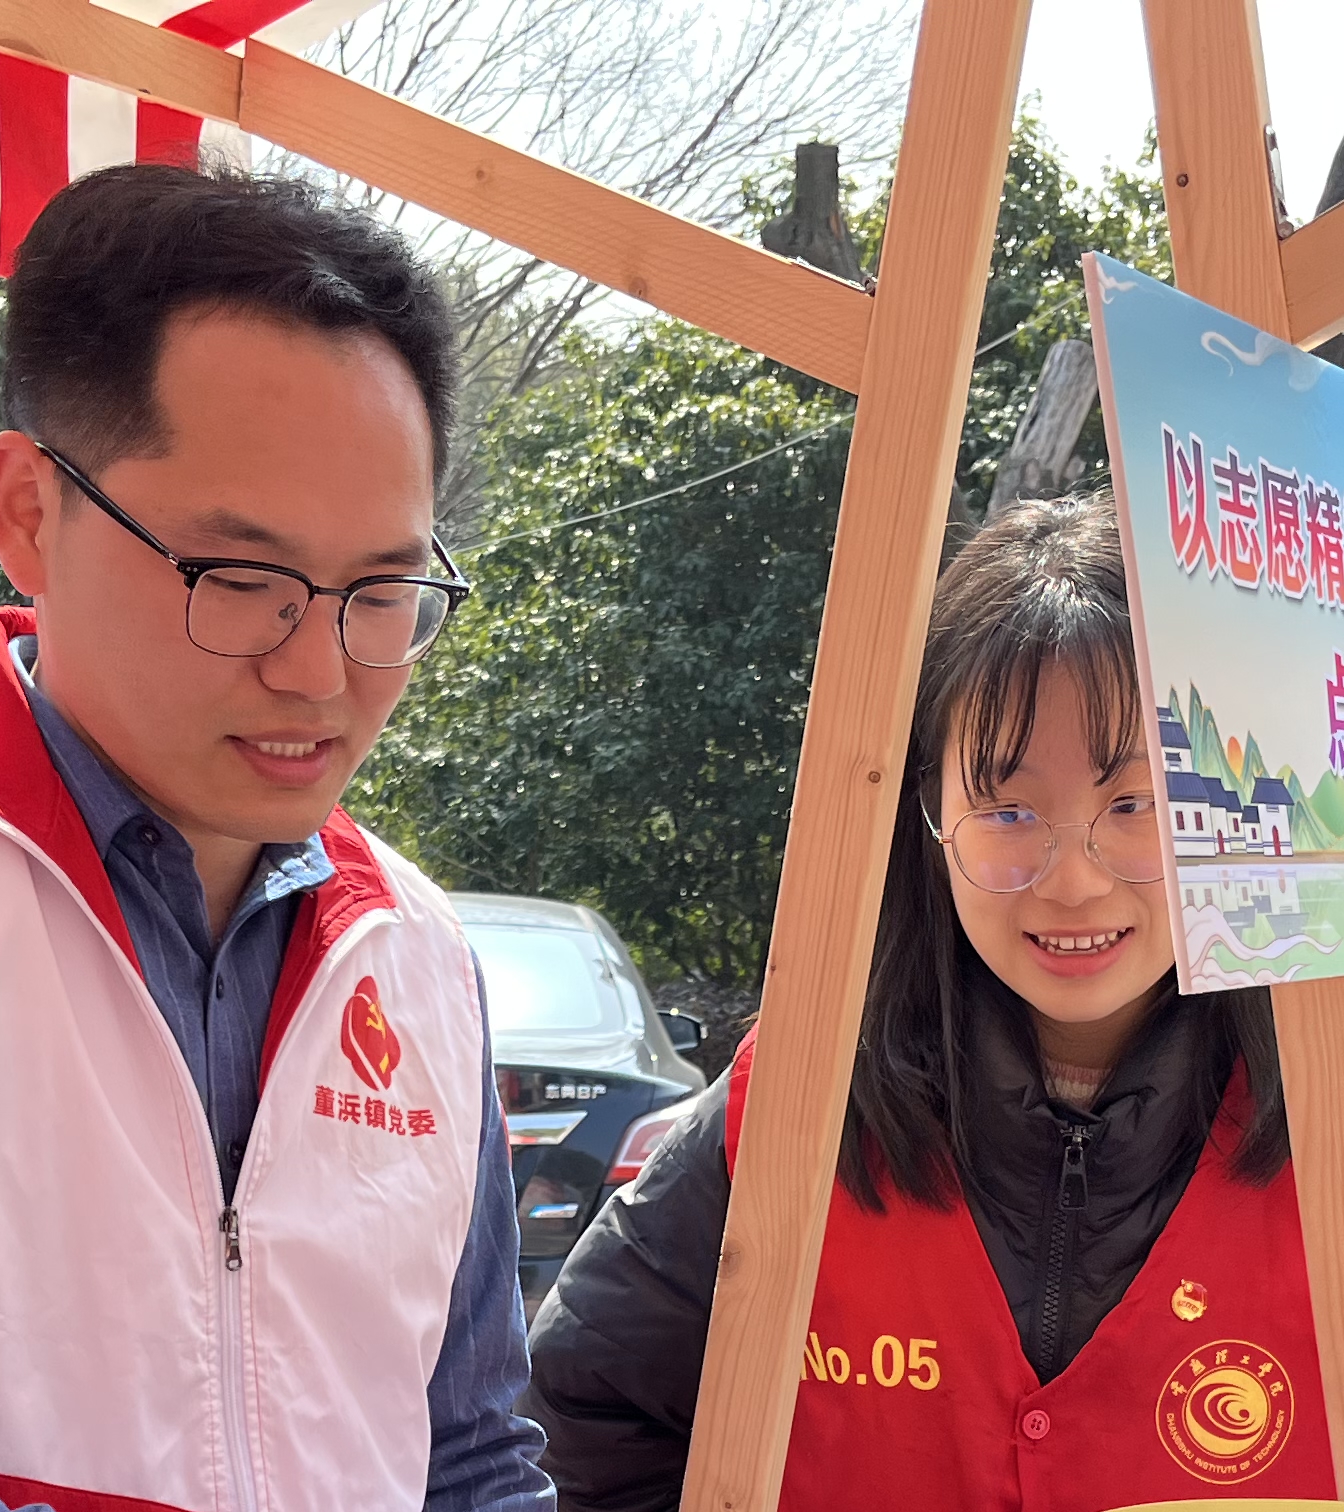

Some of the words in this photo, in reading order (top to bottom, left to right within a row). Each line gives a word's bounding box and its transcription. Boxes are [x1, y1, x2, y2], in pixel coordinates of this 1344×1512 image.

[312, 1084, 438, 1137] 董浜镇党委
[1194, 1456, 1238, 1475] INSTITUTE
